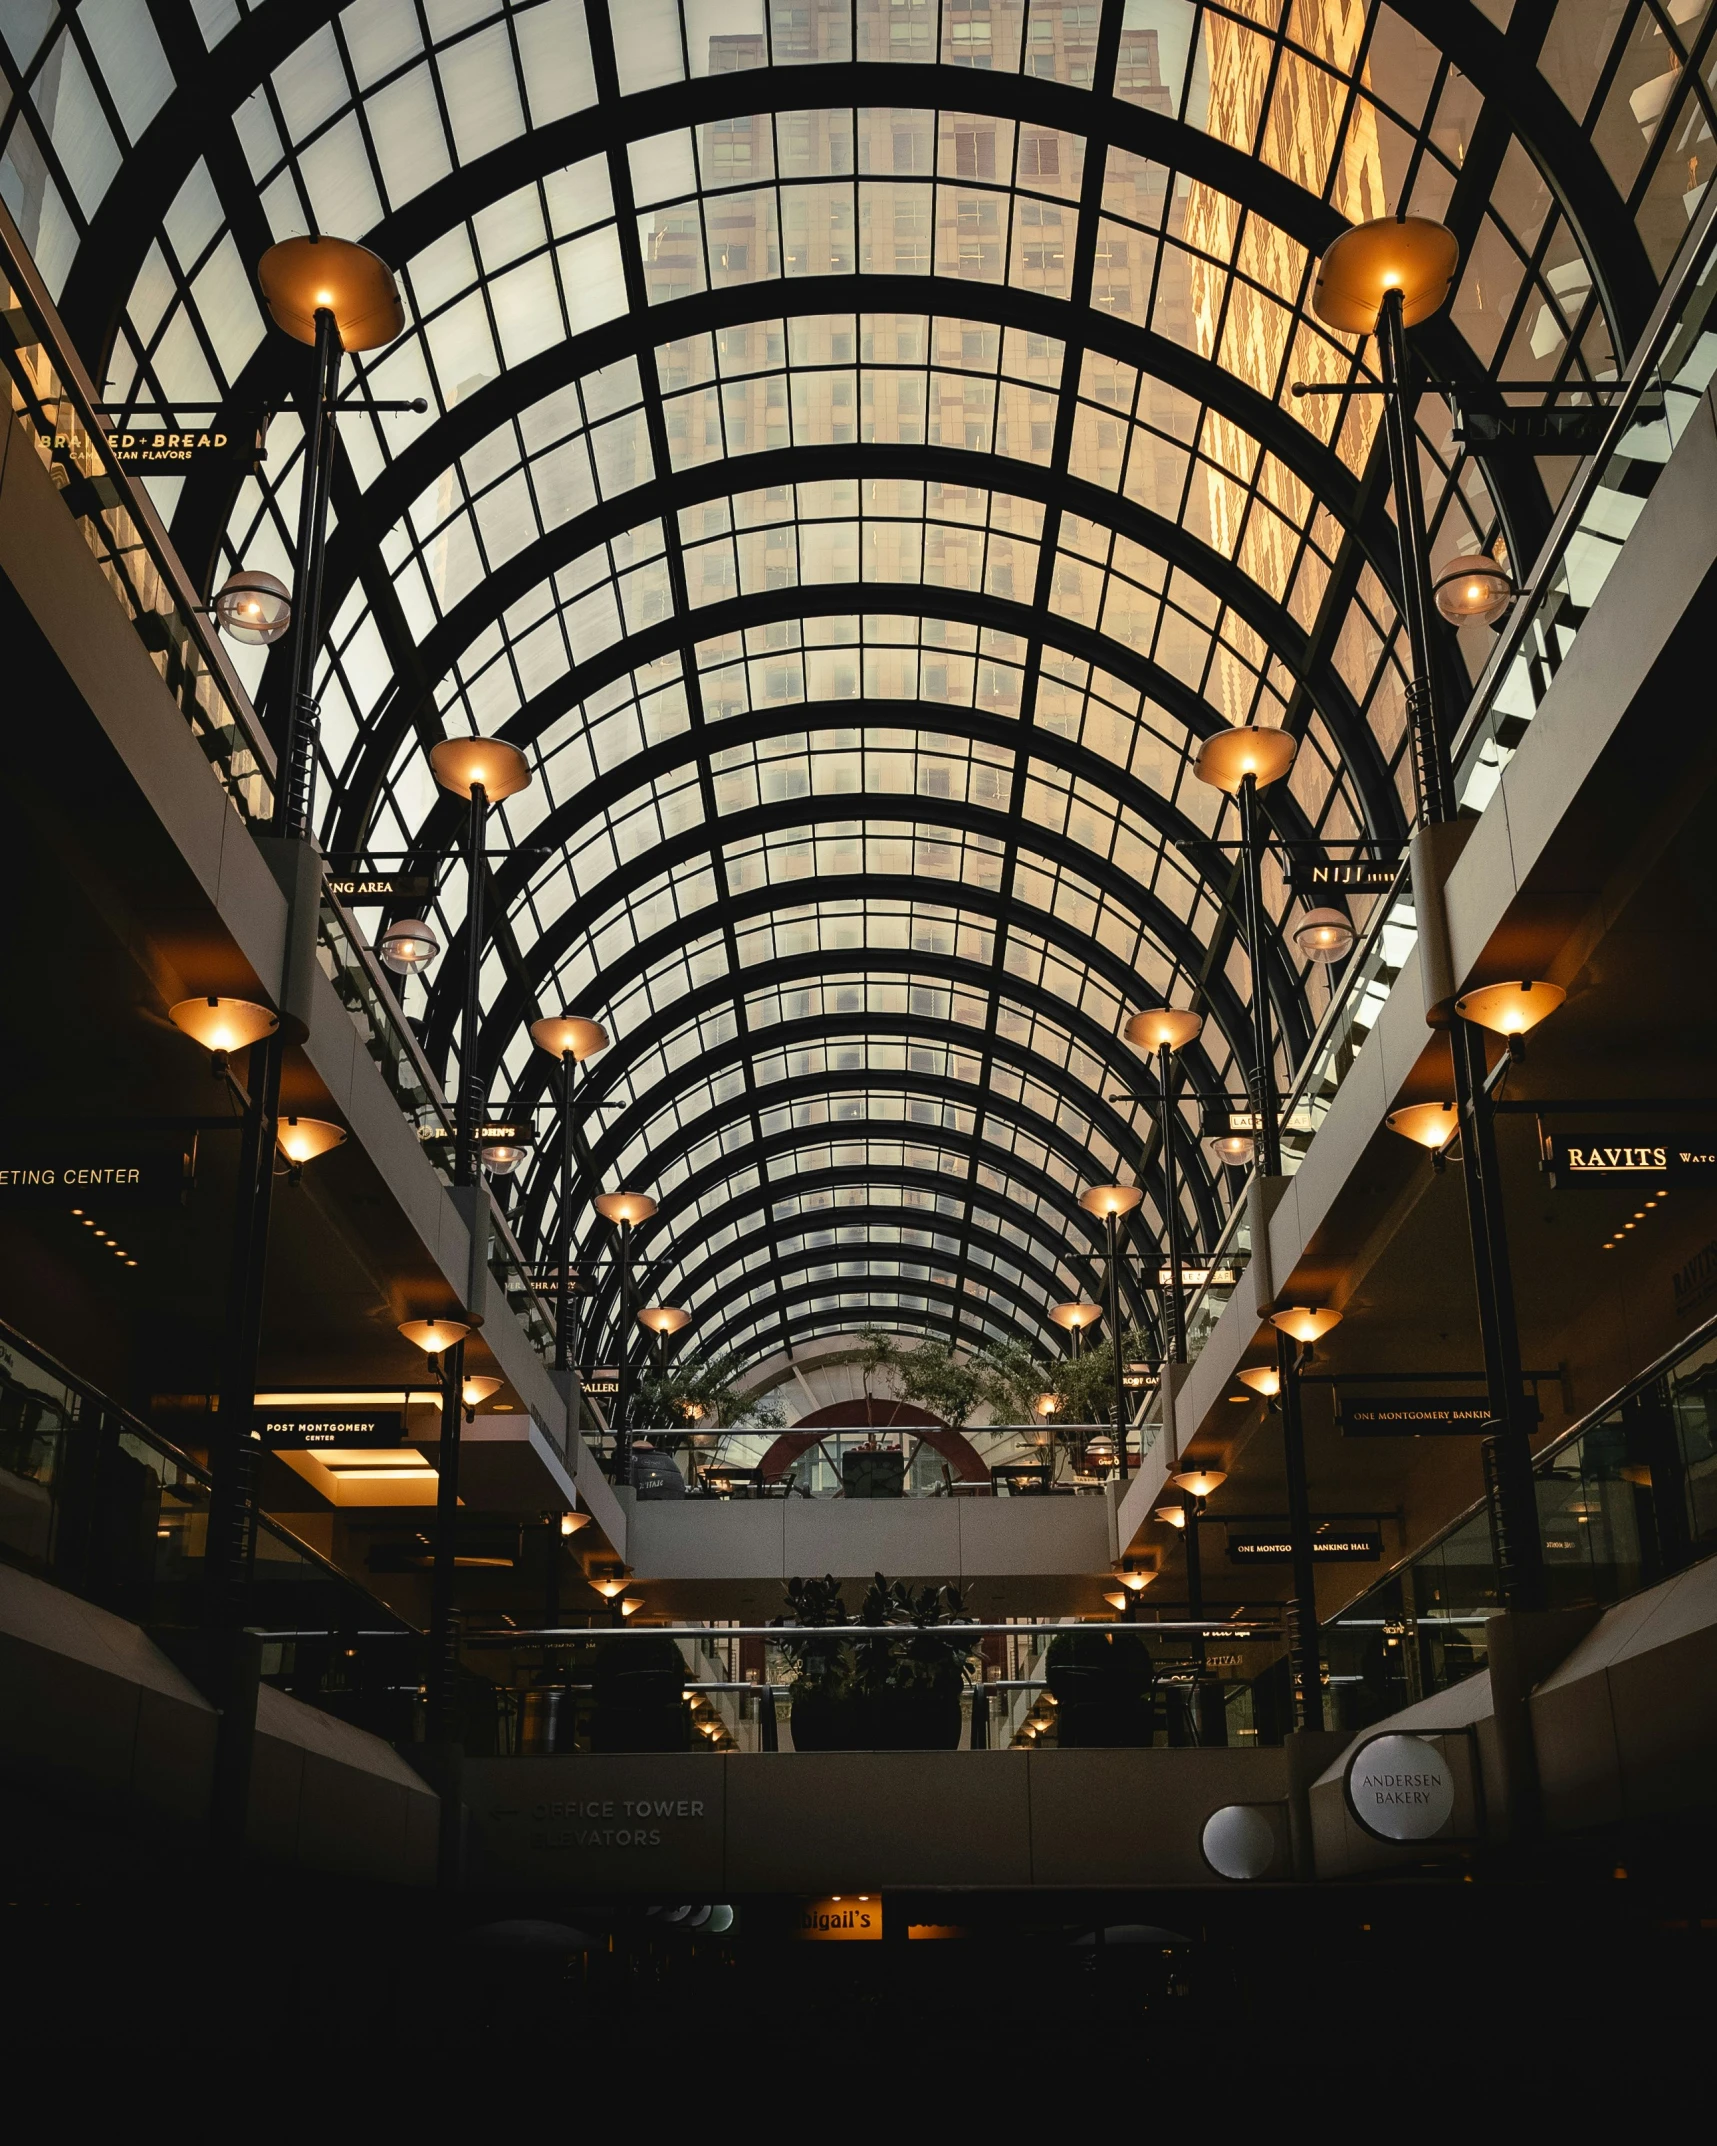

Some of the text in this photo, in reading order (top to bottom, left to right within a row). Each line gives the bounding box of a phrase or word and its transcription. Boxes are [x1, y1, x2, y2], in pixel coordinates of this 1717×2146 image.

[38, 434, 135, 448] BRAED
[152, 433, 228, 448] BREAD
[142, 450, 192, 461] FLAVORS
[1312, 867, 1362, 883] NIJI
[357, 882, 393, 893] AREA
[1567, 1148, 1667, 1167] RAVITS
[63, 1168, 140, 1184] CENTER
[1353, 1410, 1492, 1421] ONE MONTGOMERY BANKIN
[266, 1423, 375, 1432] POST MONTGOMERY
[1256, 1544, 1292, 1552] MONTGO
[1313, 1543, 1349, 1551] BANKING
[1363, 1774, 1441, 1787] ANDERSEN
[1375, 1791, 1430, 1804] BAKERY
[532, 1800, 704, 1819] OFFICE TOWER
[530, 1829, 661, 1848] ELEVATORS
[802, 1910, 871, 1931] bigail's
